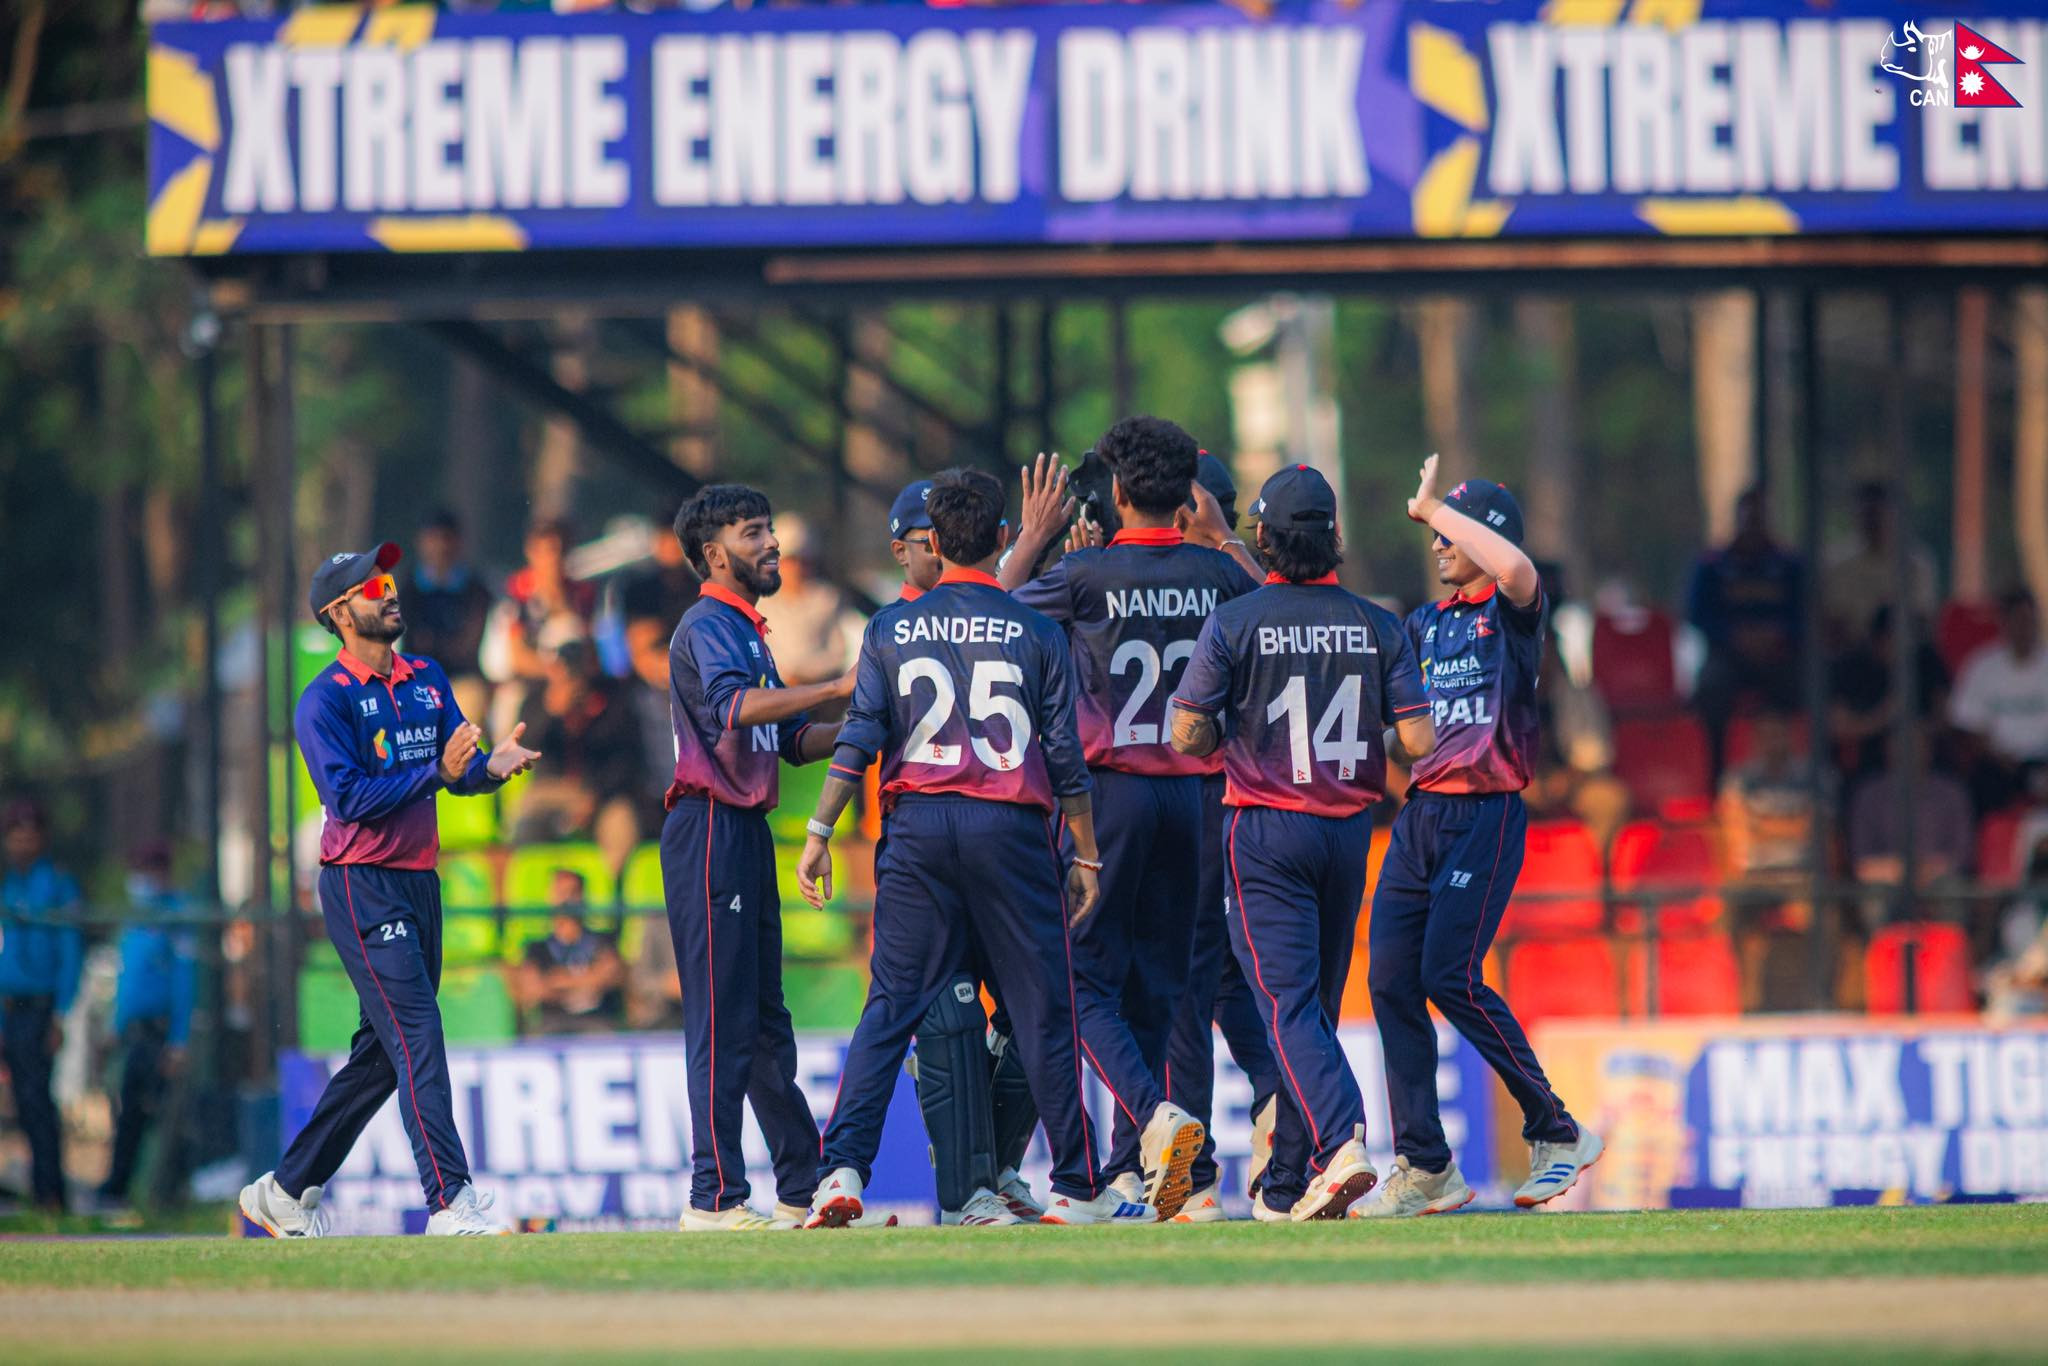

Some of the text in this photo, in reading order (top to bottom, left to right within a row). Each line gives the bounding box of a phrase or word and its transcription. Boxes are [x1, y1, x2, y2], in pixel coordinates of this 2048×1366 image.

[222, 24, 1370, 212] XTREME ENERGY DRINK
[1487, 19, 1900, 194] XTREME
[1105, 588, 1218, 619] NANDAN
[894, 615, 1024, 645] SANDEEP
[1258, 625, 1378, 655] BHURTEL
[1433, 655, 1481, 676] NAASA
[1431, 676, 1484, 689] ECURITIES
[897, 657, 1032, 772] 25
[1430, 696, 1493, 727] PAL
[1267, 675, 1369, 784] 14
[729, 894, 743, 913] 4
[380, 920, 408, 942] 24
[1707, 1040, 1907, 1131] MAX
[1708, 1130, 1947, 1196] ENERGY
